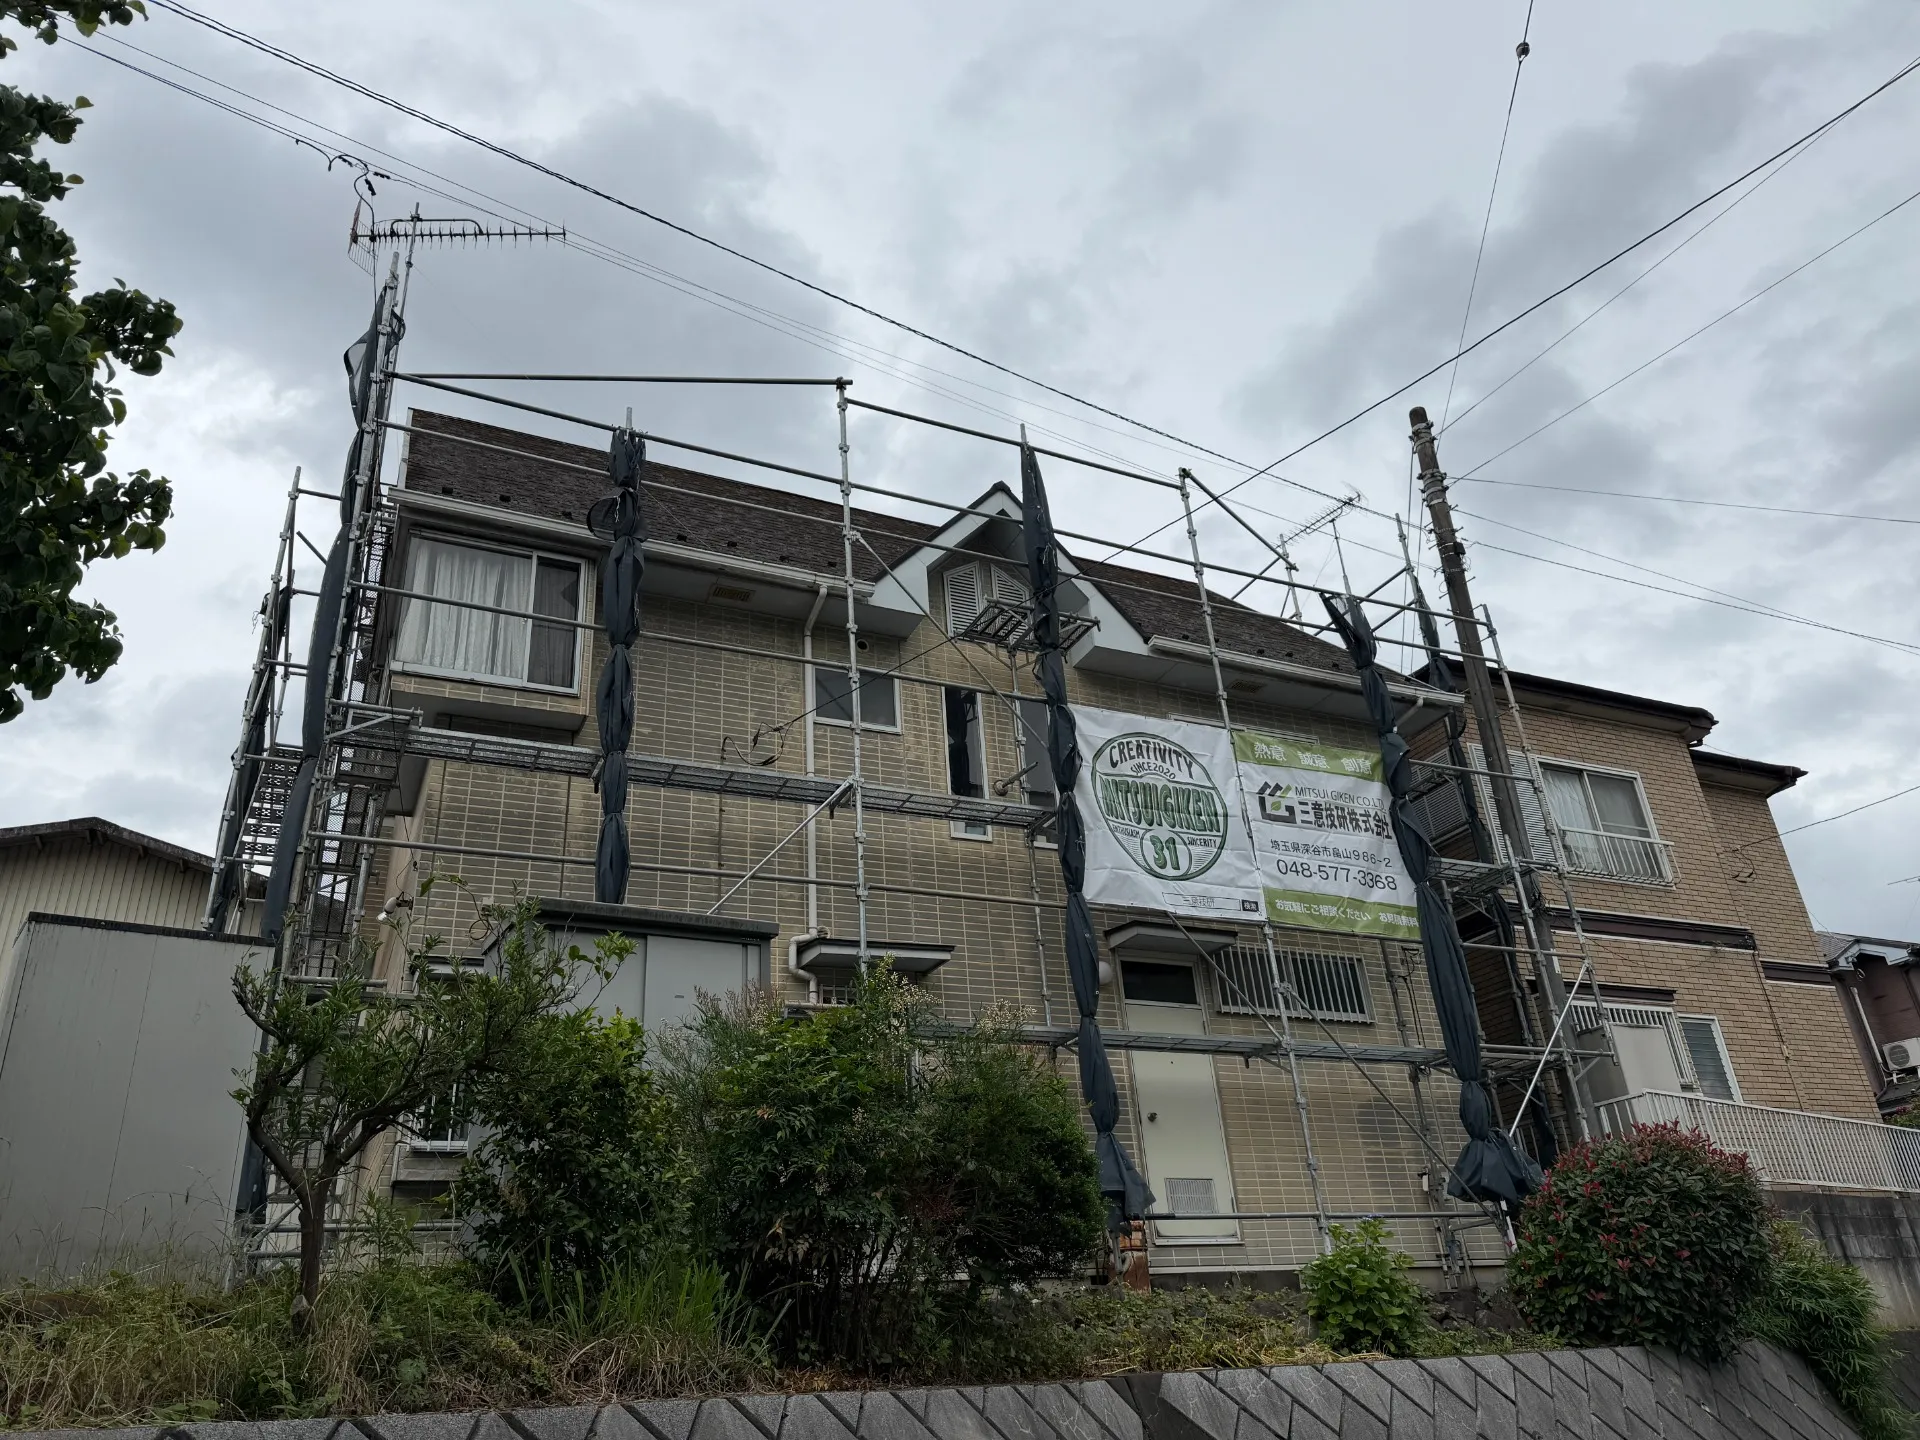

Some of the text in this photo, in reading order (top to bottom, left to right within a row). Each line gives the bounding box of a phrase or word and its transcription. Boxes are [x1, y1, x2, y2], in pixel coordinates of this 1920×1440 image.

[1109, 740, 1194, 780] CREATIVITY
[1253, 741, 1372, 775] 熱意 誠意 創意
[1098, 775, 1221, 833] MITSUIGIKEN
[1295, 786, 1329, 799] MITSUI
[1330, 790, 1355, 804] GIKEN
[1297, 800, 1393, 840] 三意技研株式会社
[1149, 834, 1181, 871] 31
[1186, 836, 1218, 848] SINCERITY
[1276, 859, 1398, 891] 048-577-3368
[1274, 898, 1371, 921] お気軽にご相談ください
